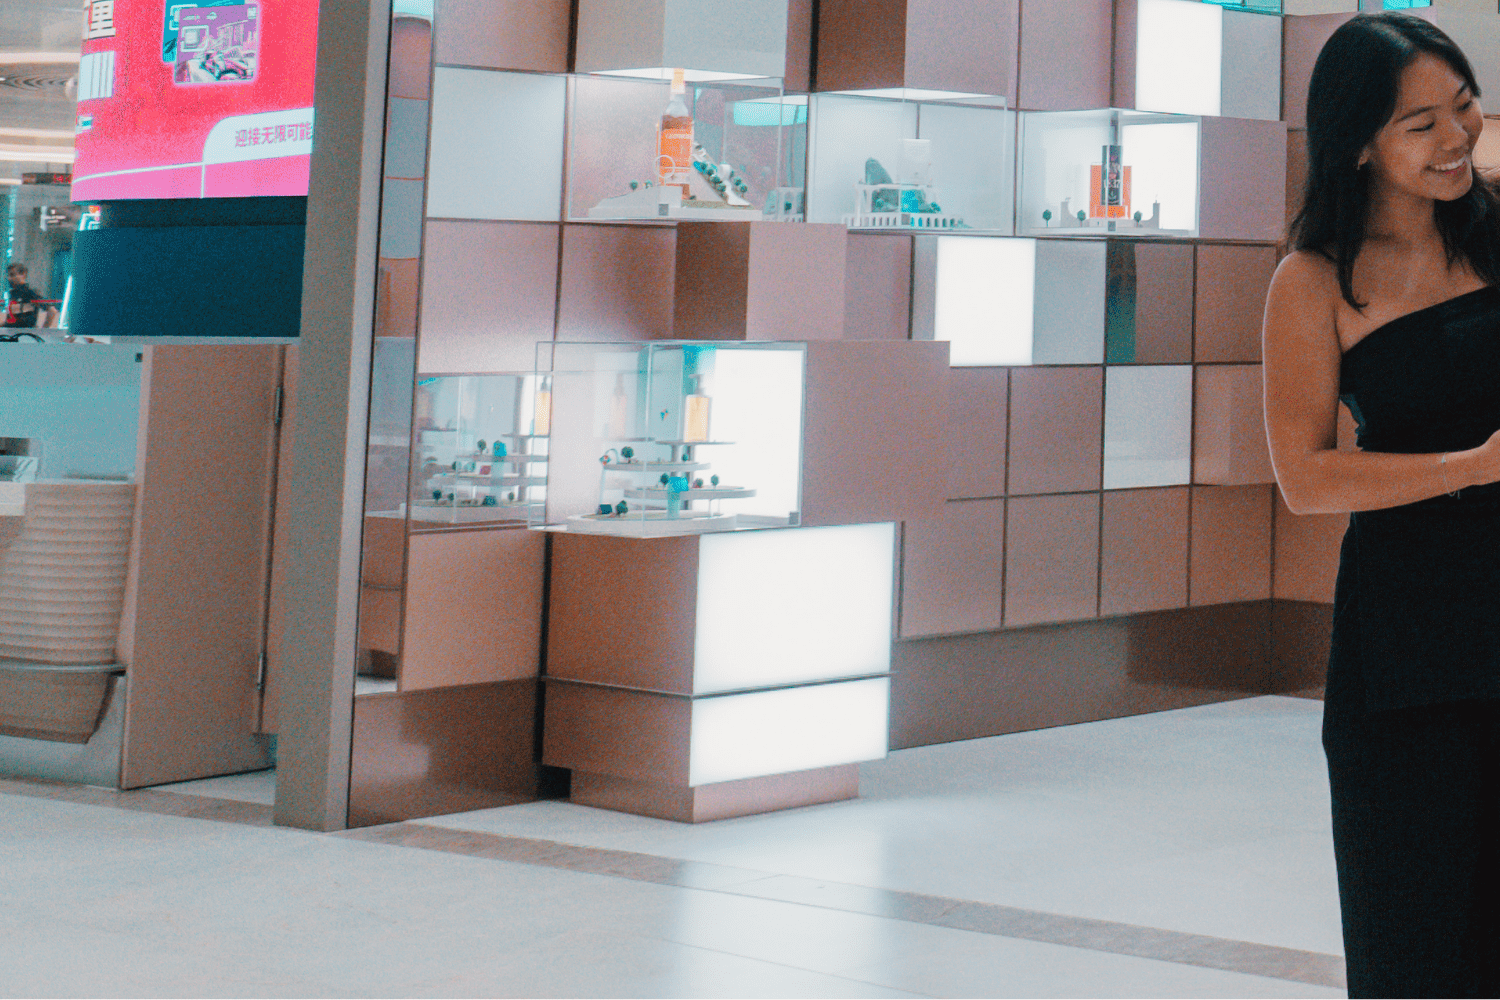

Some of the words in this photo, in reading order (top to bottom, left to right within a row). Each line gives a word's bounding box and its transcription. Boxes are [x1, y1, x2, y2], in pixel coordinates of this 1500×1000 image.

[234, 121, 313, 148] 迎接无限可能
